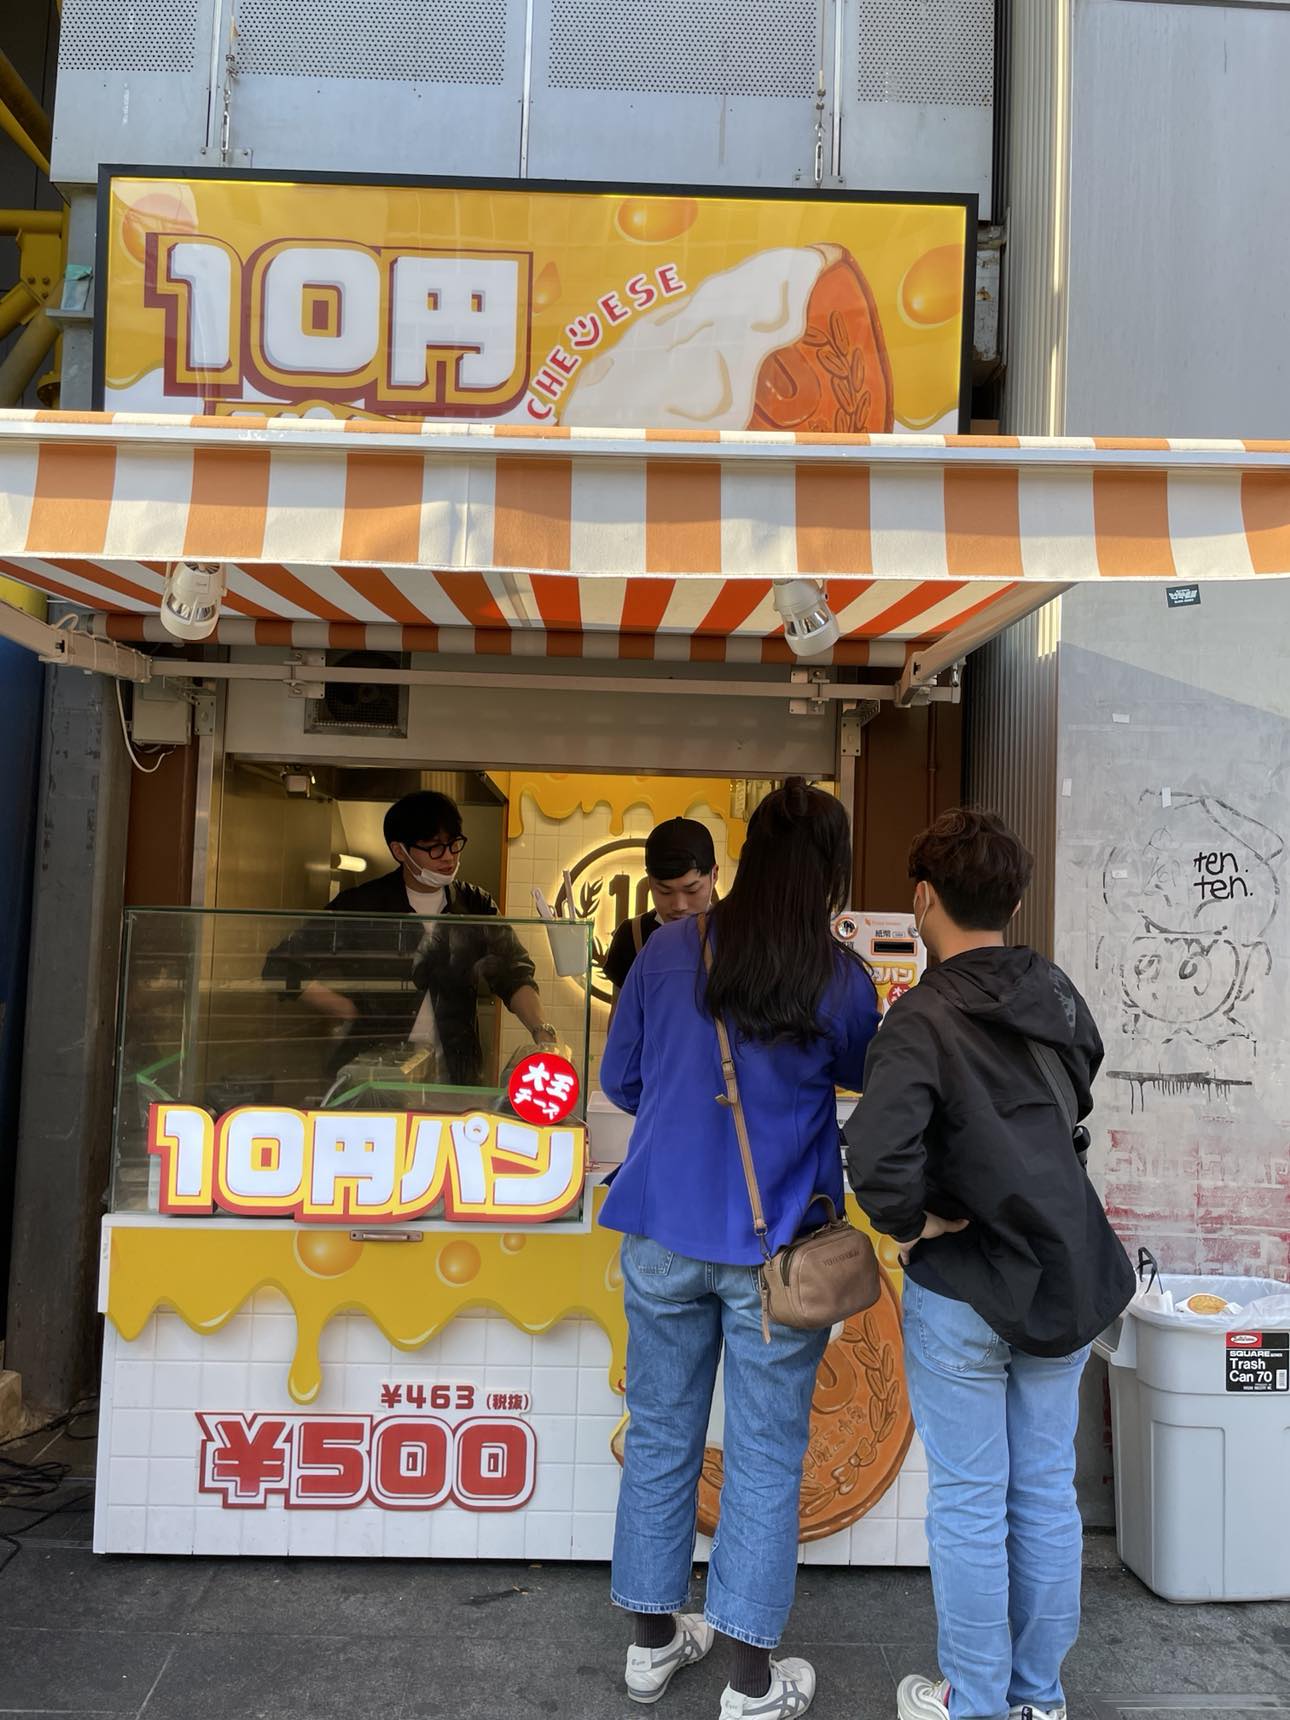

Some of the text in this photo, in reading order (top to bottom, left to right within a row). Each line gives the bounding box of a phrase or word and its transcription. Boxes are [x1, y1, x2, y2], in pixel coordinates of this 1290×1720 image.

[152, 234, 527, 405] 10円
[521, 1062, 574, 1102] 大王
[156, 1107, 580, 1214] 10円パン
[1229, 1358, 1266, 1370] Trash
[1229, 1370, 1273, 1382] Can 70
[381, 1384, 475, 1409] ¥463
[203, 1415, 532, 1504] ¥500
